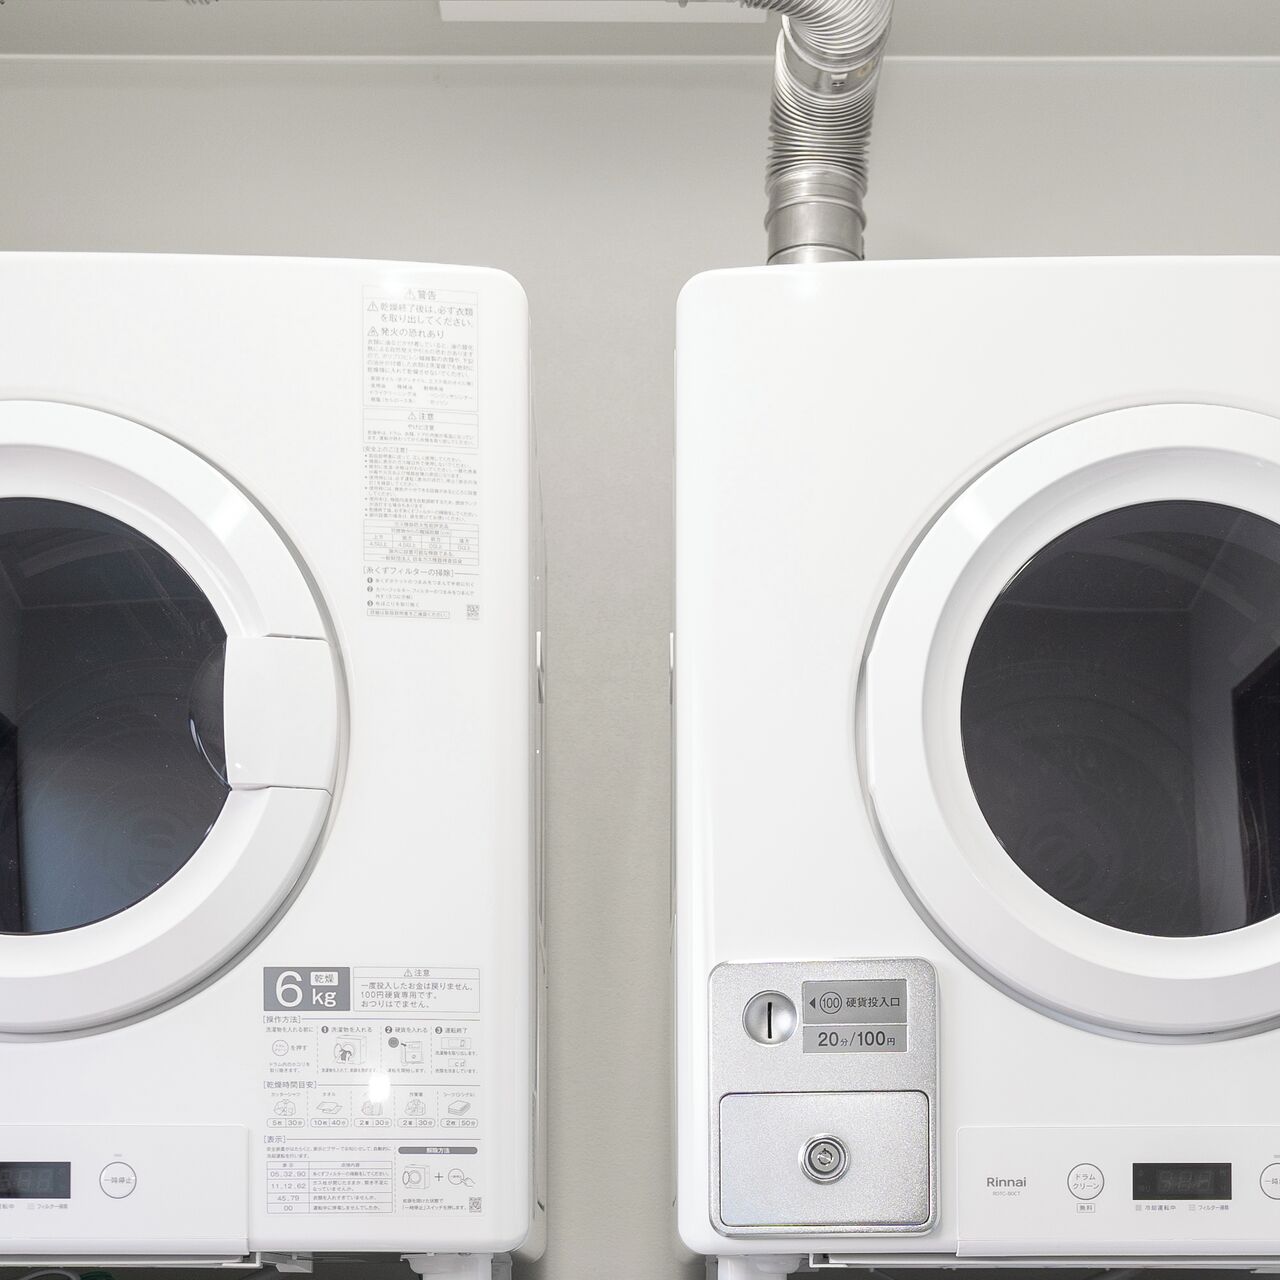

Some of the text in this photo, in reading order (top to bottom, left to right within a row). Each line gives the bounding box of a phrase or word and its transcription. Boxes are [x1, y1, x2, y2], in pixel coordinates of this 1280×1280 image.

[314, 974, 334, 984] 乾燥
[275, 971, 303, 1007] 6
[361, 982, 473, 991] 一度投入したお金は戻りません。
[312, 989, 336, 1007] kg
[361, 991, 438, 999] 100円硬貨専用です。
[361, 1000, 429, 1009] おつりはでません。
[822, 997, 900, 1008] 100 硬貨投入口
[818, 1032, 896, 1047] 20分/100円
[1074, 1173, 1096, 1181] ドラム
[987, 1177, 1026, 1188] Rinnai
[1073, 1182, 1099, 1190] クリーン
